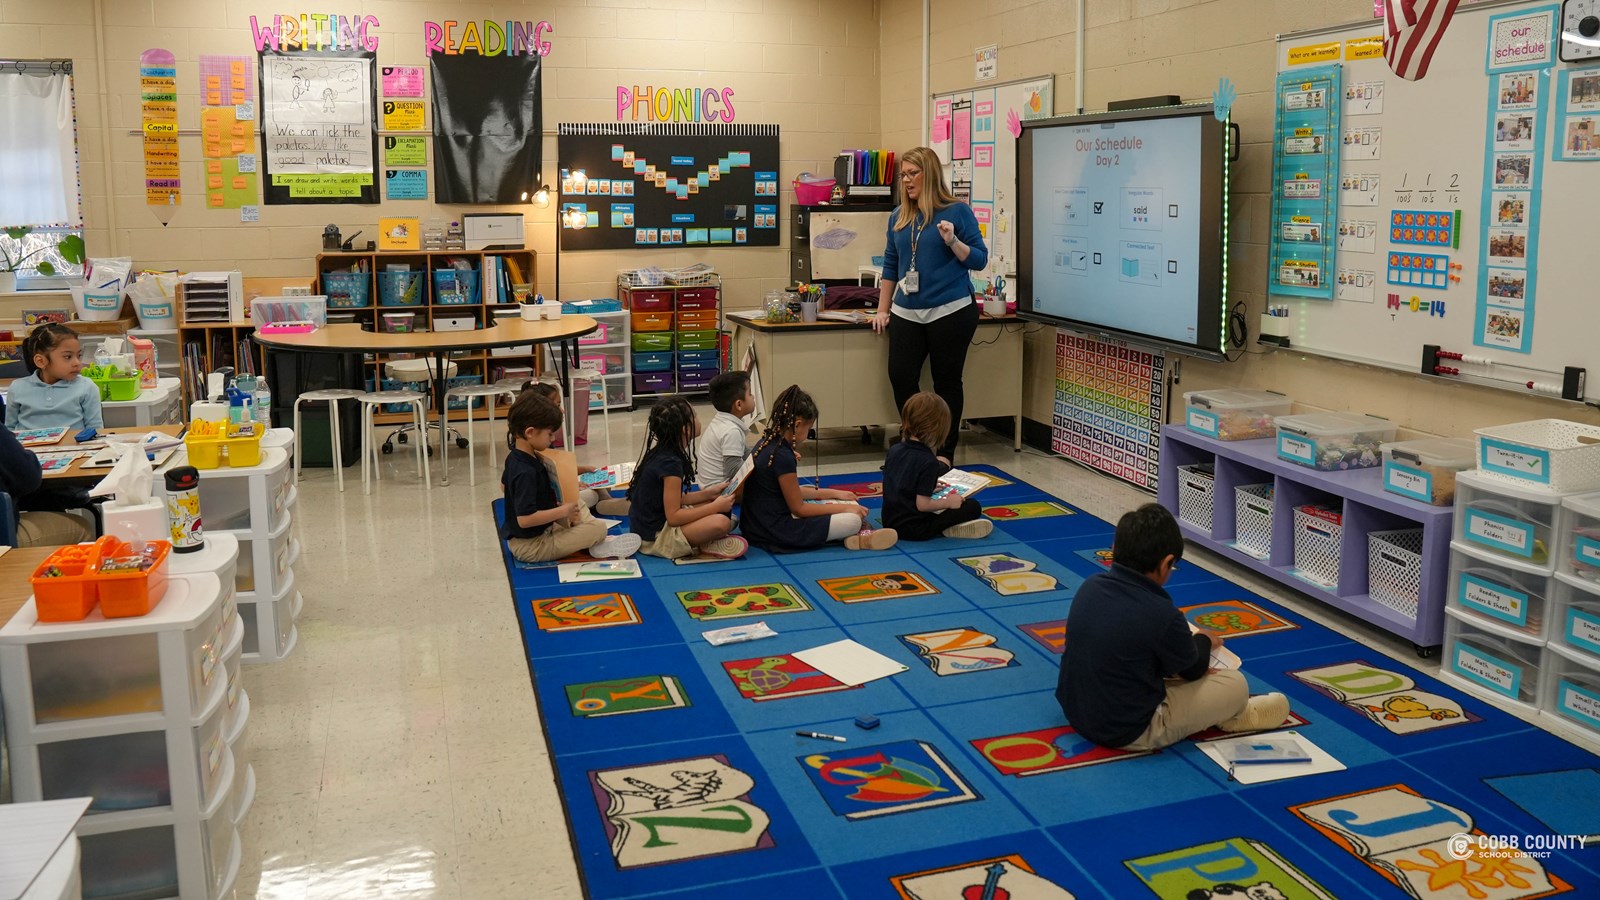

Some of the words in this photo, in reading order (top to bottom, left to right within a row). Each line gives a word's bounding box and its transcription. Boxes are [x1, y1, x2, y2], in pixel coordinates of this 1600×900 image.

[249, 13, 380, 52] WRITING
[424, 20, 553, 57] READING
[1511, 27, 1531, 38] our
[1318, 47, 1338, 55] learning?
[1355, 49, 1372, 57] learned
[1496, 41, 1545, 58] schedule
[616, 85, 735, 123] PHONICS
[147, 124, 174, 132] Capital
[276, 123, 295, 137] We
[301, 127, 318, 137] can
[322, 123, 339, 137] lick
[344, 125, 360, 137] the
[334, 138, 350, 151] like
[1075, 139, 1093, 152] Our
[1095, 136, 1142, 151] Schedule
[278, 151, 305, 168] good
[1096, 155, 1112, 168] Day
[1114, 154, 1120, 165] 2
[1402, 172, 1407, 188] 1
[1426, 173, 1431, 186] 1
[1450, 173, 1459, 188] 2
[309, 187, 326, 195] about
[339, 188, 354, 196] topic
[1422, 193, 1434, 203] 10's
[1133, 206, 1148, 215] said
[1153, 355, 1162, 367] 10
[1153, 368, 1162, 380] 20
[1152, 382, 1161, 393] 30
[1152, 395, 1161, 407] 40
[1151, 408, 1160, 420] 50
[1150, 435, 1159, 448] 70
[1150, 449, 1159, 462] 80
[1496, 449, 1524, 460] Turn-it-in
[1149, 462, 1158, 476] 90
[1397, 471, 1413, 482] Sensory
[1483, 520, 1504, 531] Phonics
[1483, 529, 1503, 541] Folders
[1479, 587, 1500, 601] Reading
[1468, 592, 1487, 606] Folders
[1493, 602, 1510, 613] Sheets
[1583, 622, 1600, 632] Small
[1474, 658, 1488, 669] Math
[1460, 660, 1479, 674] Folders
[1485, 671, 1501, 684] Sheets
[610, 680, 667, 702] Y
[1575, 694, 1592, 705] Small
[1572, 703, 1590, 714] White
[983, 737, 1057, 768] O
[1327, 799, 1469, 837] J
[1130, 842, 1260, 883] P
